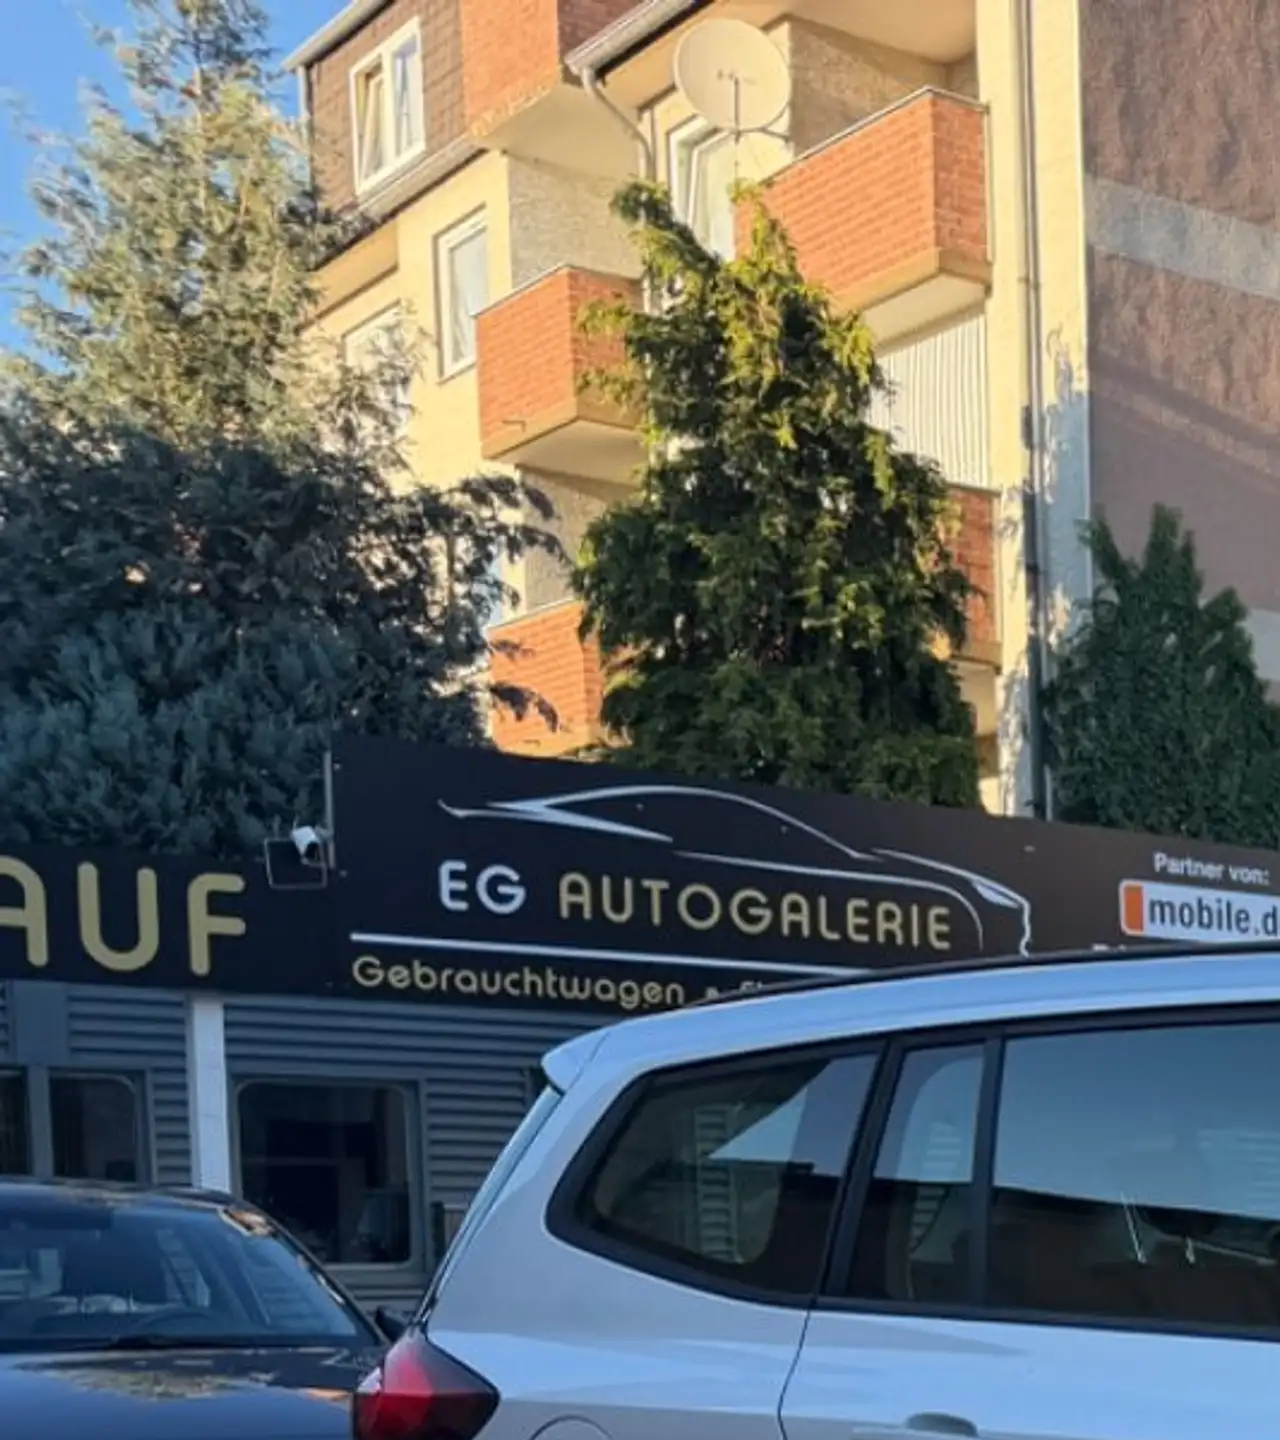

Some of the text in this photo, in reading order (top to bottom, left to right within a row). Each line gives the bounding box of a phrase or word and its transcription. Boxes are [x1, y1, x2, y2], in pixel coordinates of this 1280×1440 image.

[1154, 852, 1270, 886] Partner von:
[438, 859, 952, 950] EG AUTOGALERIE
[352, 955, 685, 1009] Gebrauchtwagen
